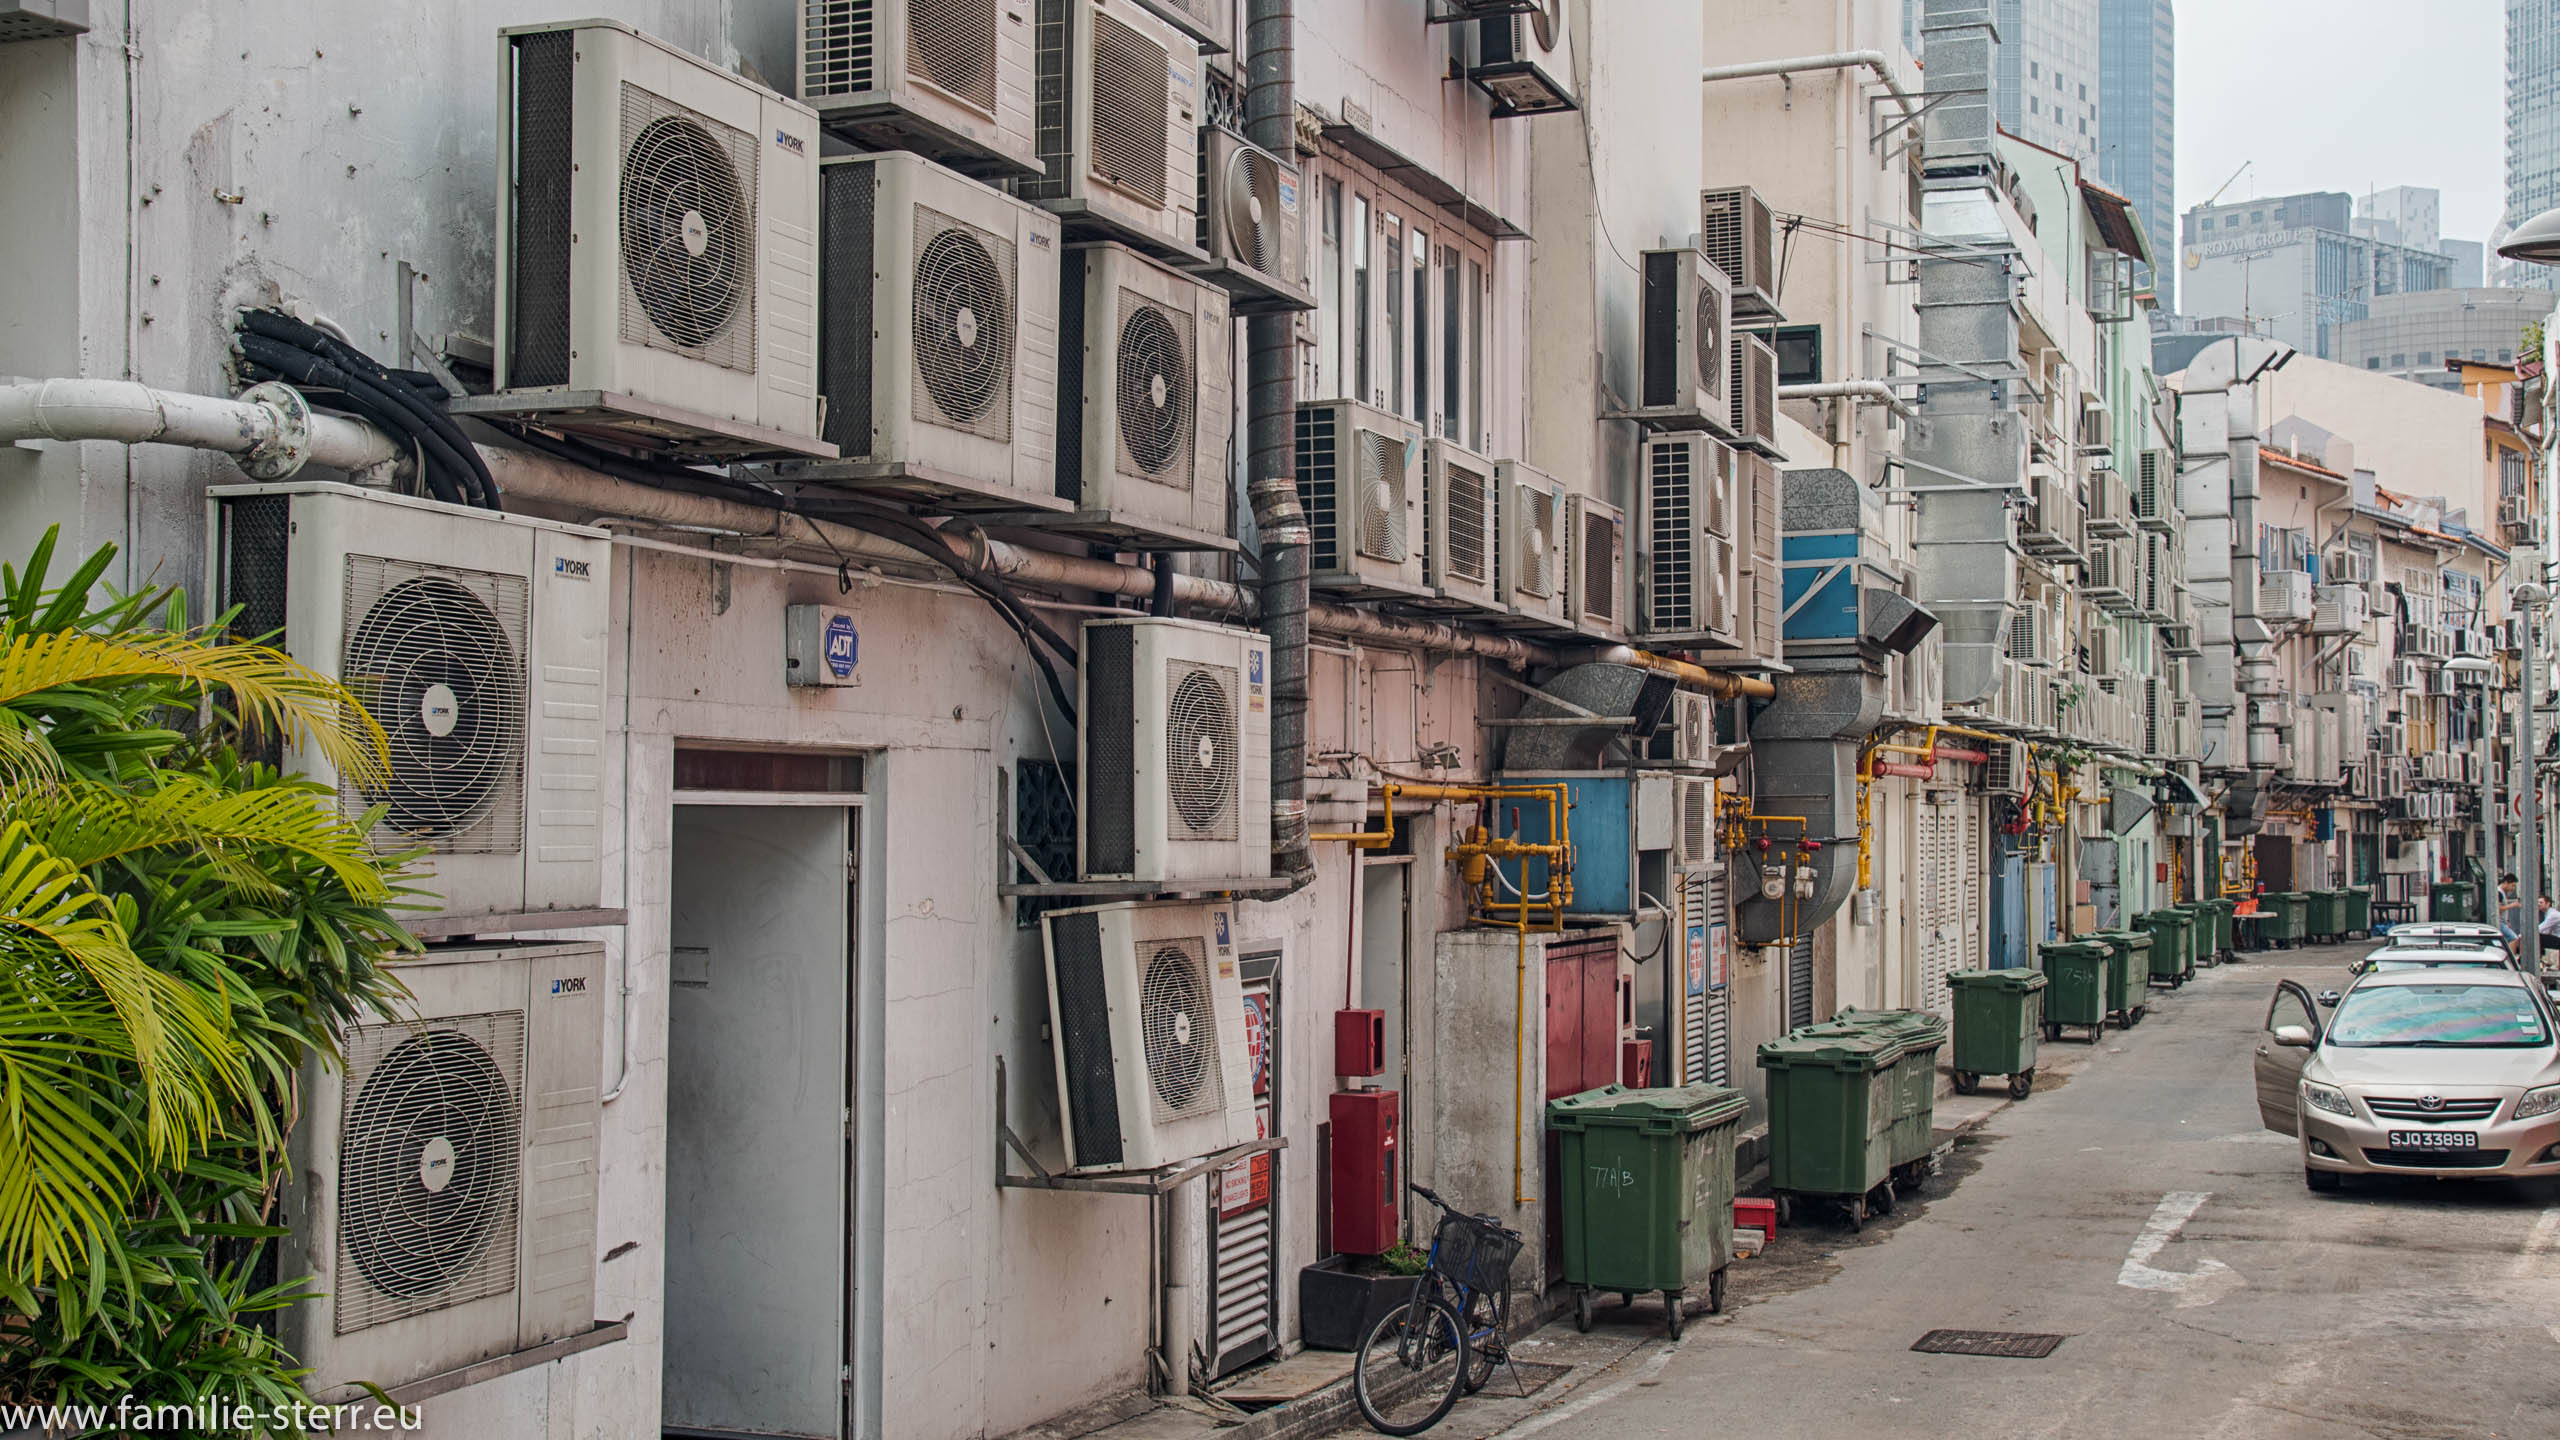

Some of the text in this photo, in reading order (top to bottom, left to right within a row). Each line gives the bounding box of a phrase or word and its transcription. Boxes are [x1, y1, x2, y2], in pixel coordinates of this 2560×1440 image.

[784, 132, 805, 153] YORK
[2204, 239, 2249, 257] ROYAL
[564, 559, 591, 576] YORK
[830, 634, 853, 657] ADT
[560, 976, 587, 992] YORK
[2390, 1132, 2476, 1147] SJQ3389B
